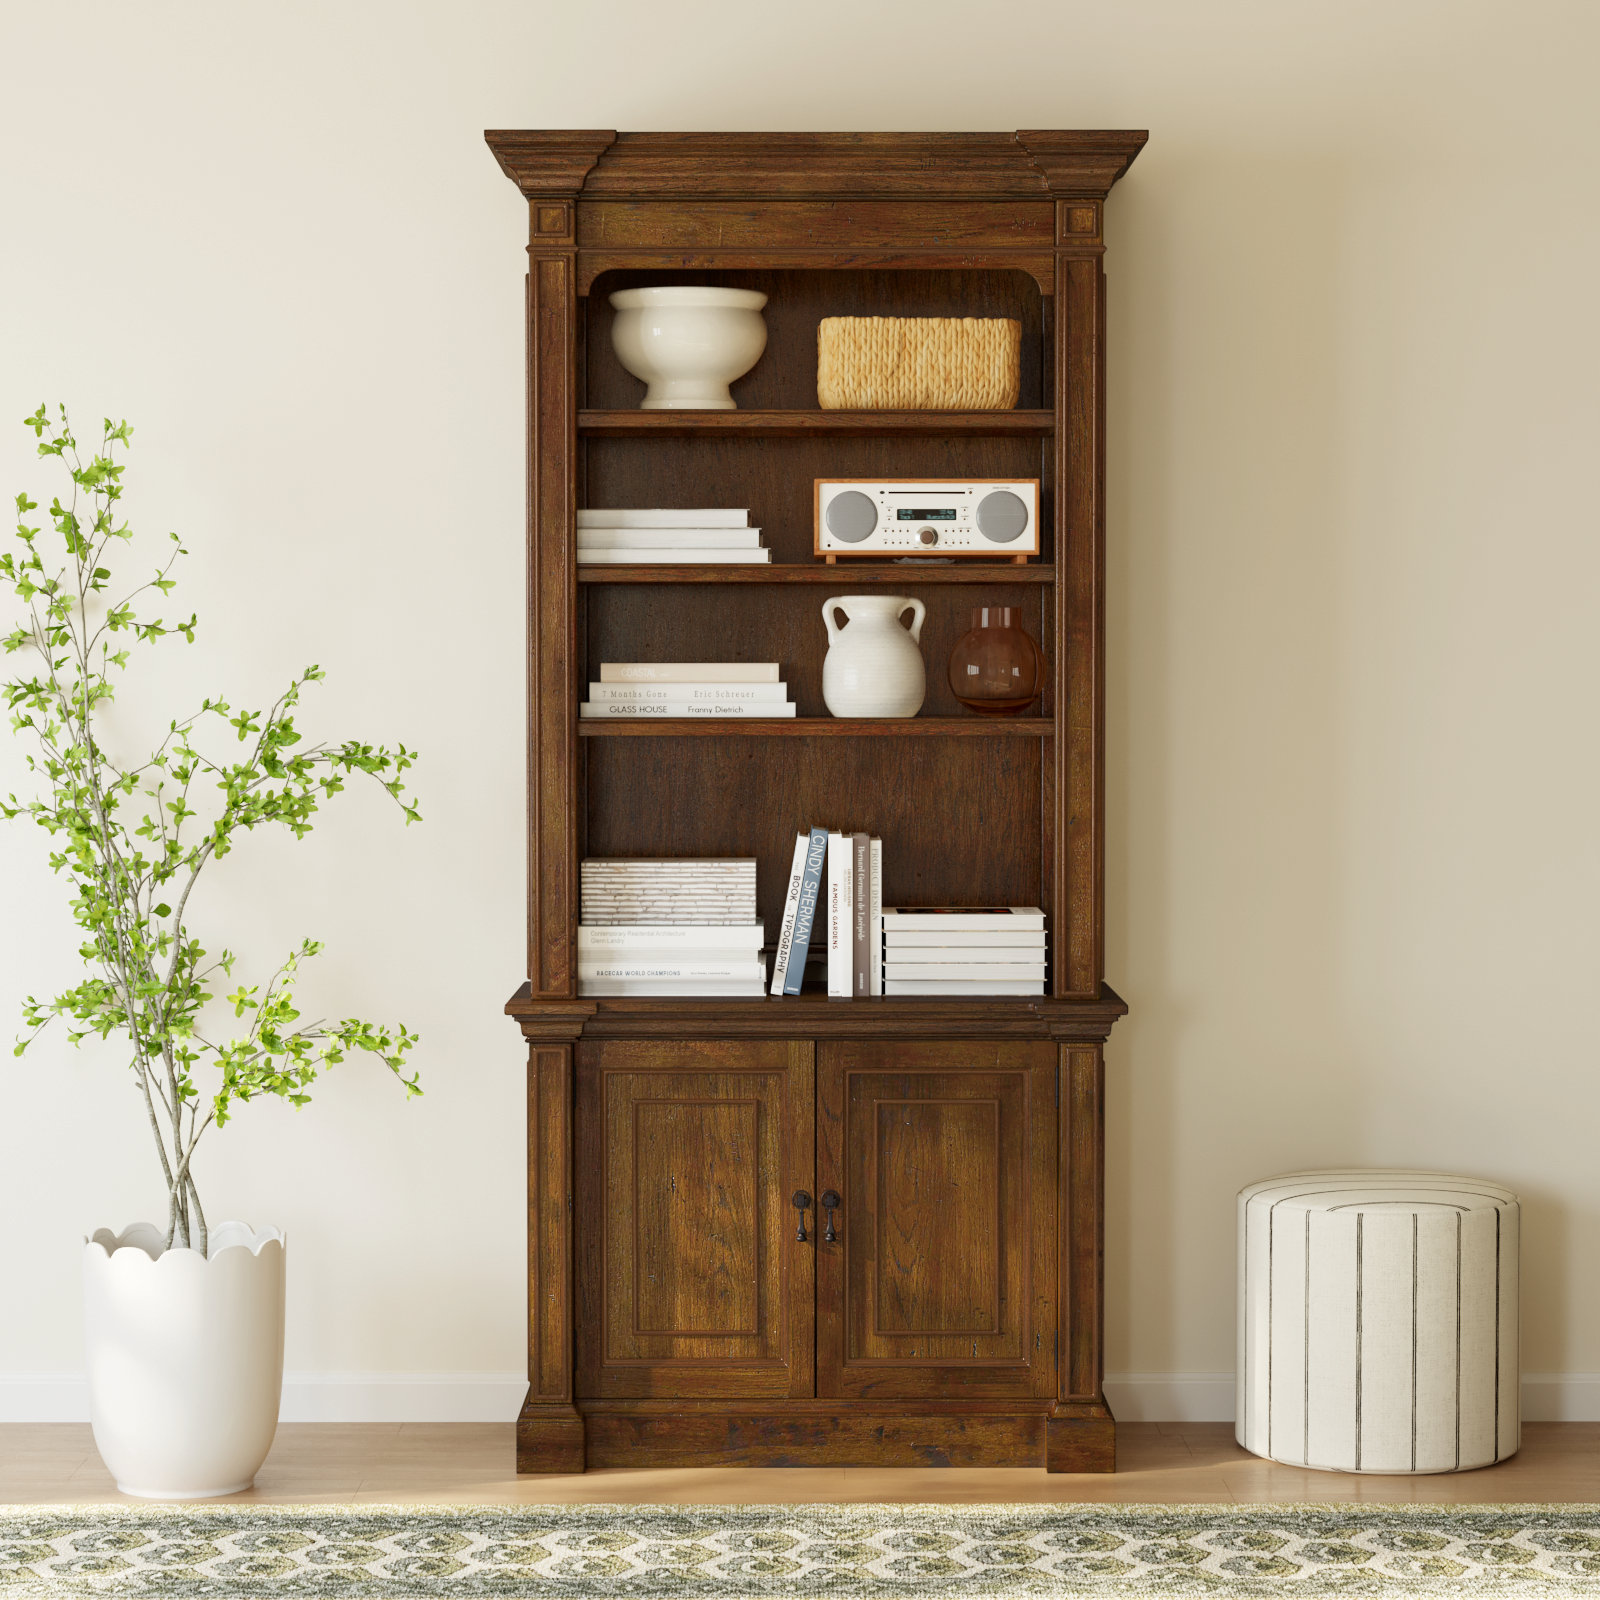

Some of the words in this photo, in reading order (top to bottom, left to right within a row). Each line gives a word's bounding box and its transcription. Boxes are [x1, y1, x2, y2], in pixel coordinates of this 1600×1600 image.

[610, 690, 642, 698] Months
[646, 690, 668, 698] Gone
[694, 690, 712, 698] Eric
[609, 705, 637, 713] GLASS
[639, 705, 668, 713] HOUSE
[687, 705, 712, 714] Franny
[715, 705, 744, 713] Dietrich
[808, 835, 825, 876] CINDY
[858, 846, 866, 872] Bernard
[871, 848, 879, 888] PRODUCT
[789, 875, 801, 901] BOOK
[858, 873, 866, 902] Germain
[794, 880, 818, 945] SHERMAN
[858, 902, 866, 911] de
[871, 889, 879, 920] DESIGN
[776, 913, 795, 974] TYPOGRAPHY
